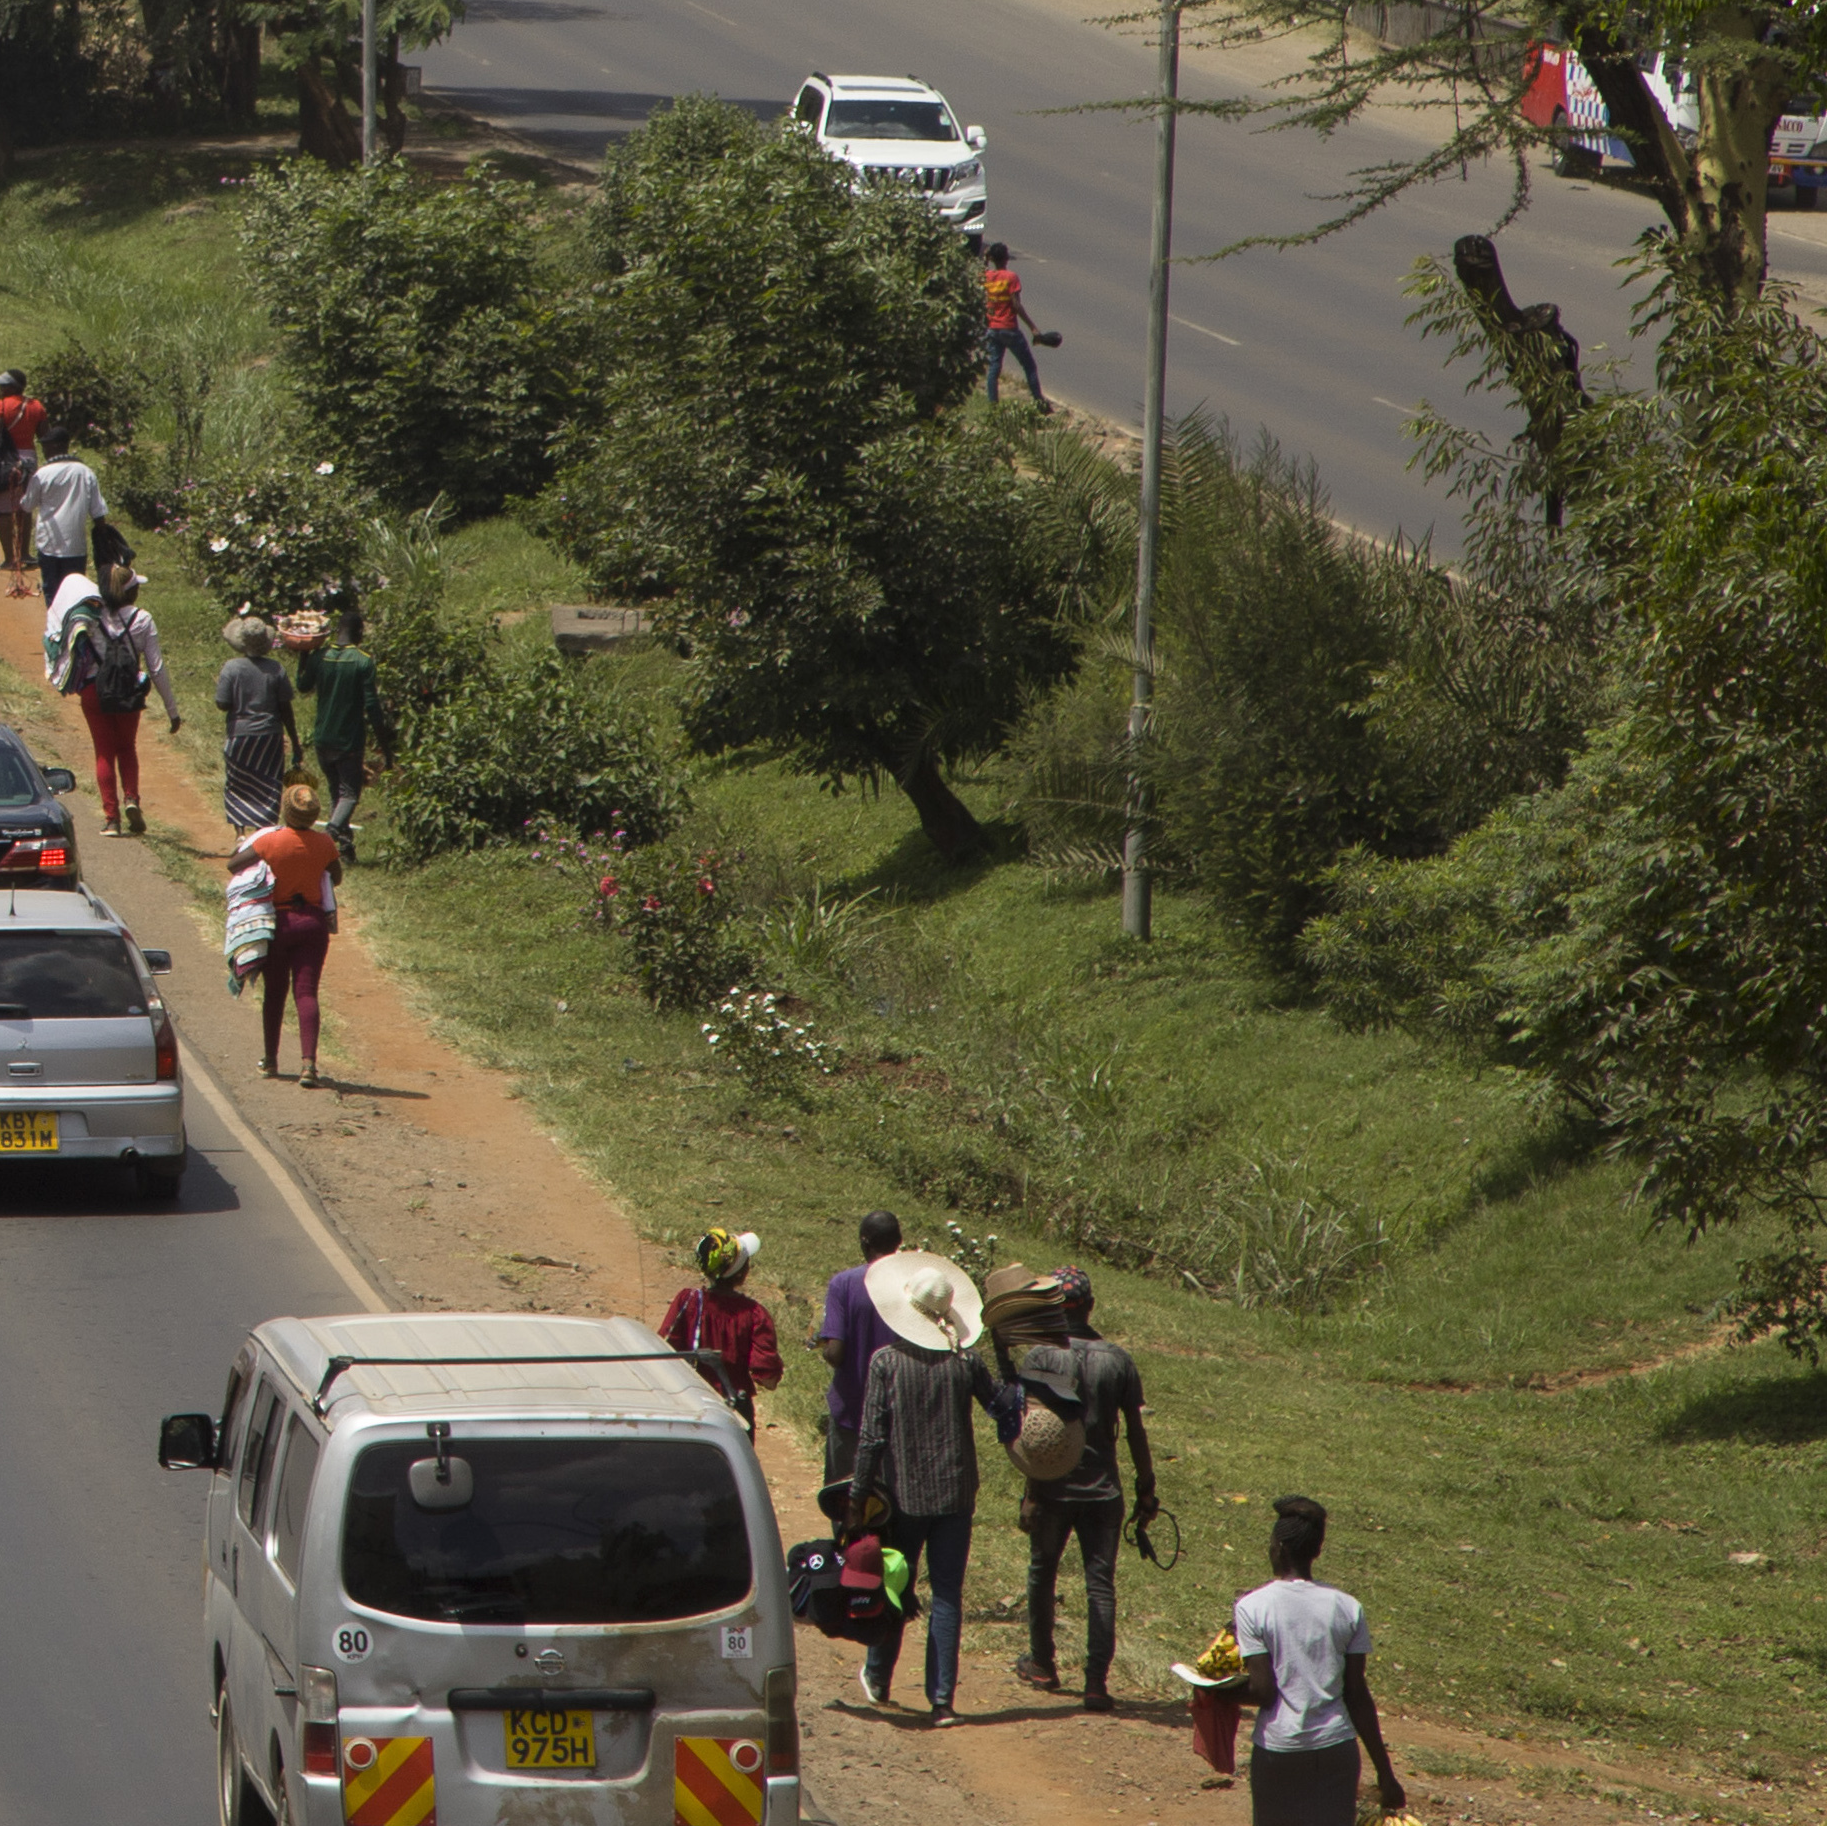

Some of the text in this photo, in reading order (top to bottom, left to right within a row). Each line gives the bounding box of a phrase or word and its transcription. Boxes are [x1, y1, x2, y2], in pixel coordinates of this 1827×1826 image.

[0, 1112, 36, 1129] KBY
[0, 1131, 52, 1148] 831M
[339, 1630, 367, 1653] 80
[728, 1636, 746, 1650] 80
[511, 1711, 568, 1735] KCD
[511, 1737, 589, 1764] 975H
